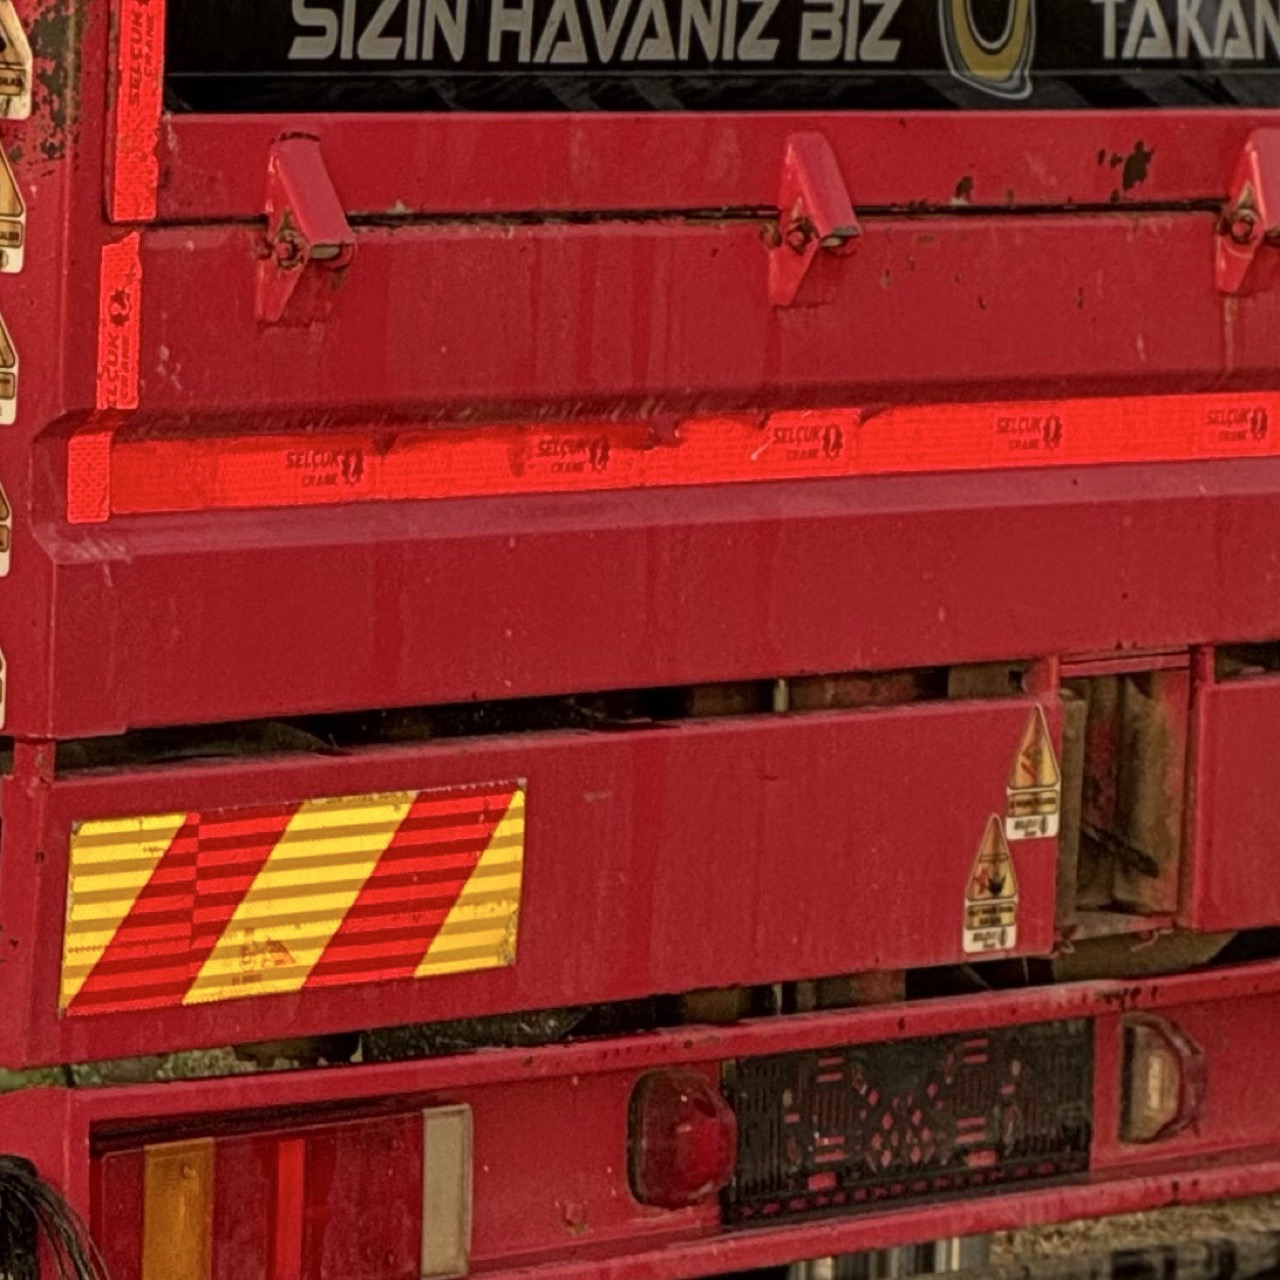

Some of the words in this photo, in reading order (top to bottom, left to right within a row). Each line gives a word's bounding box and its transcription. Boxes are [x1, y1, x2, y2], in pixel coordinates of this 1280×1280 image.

[129, 11, 143, 108] SELÇUK
[107, 332, 120, 408] LÇUK
[284, 449, 341, 472] SELÇUK
